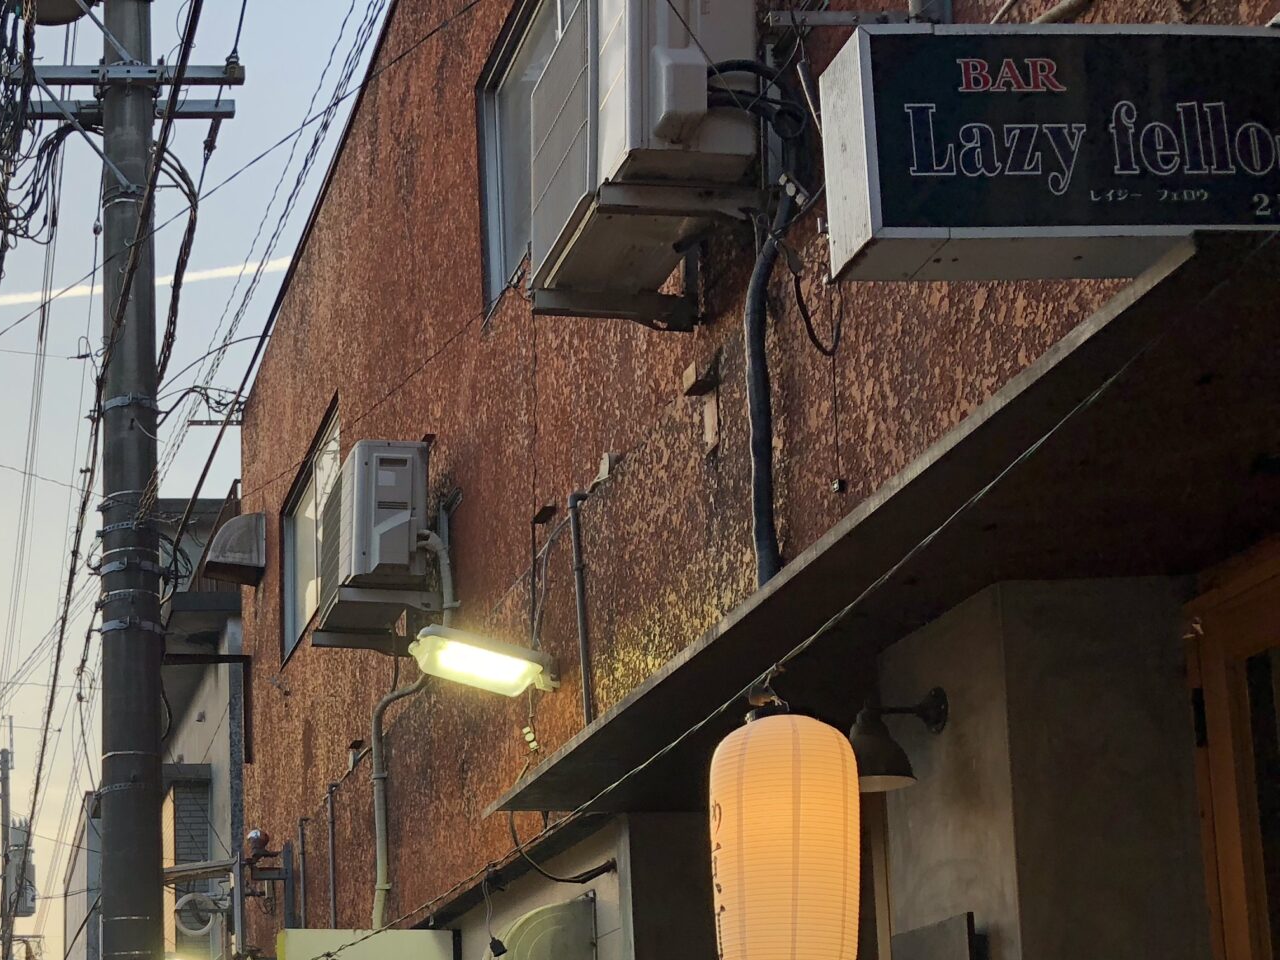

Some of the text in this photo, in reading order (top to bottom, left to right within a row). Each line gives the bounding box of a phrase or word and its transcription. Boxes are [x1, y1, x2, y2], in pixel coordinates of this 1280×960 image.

[956, 58, 1067, 92] BAR
[904, 100, 1280, 195] Lazy fello
[1253, 193, 1280, 215] 2
